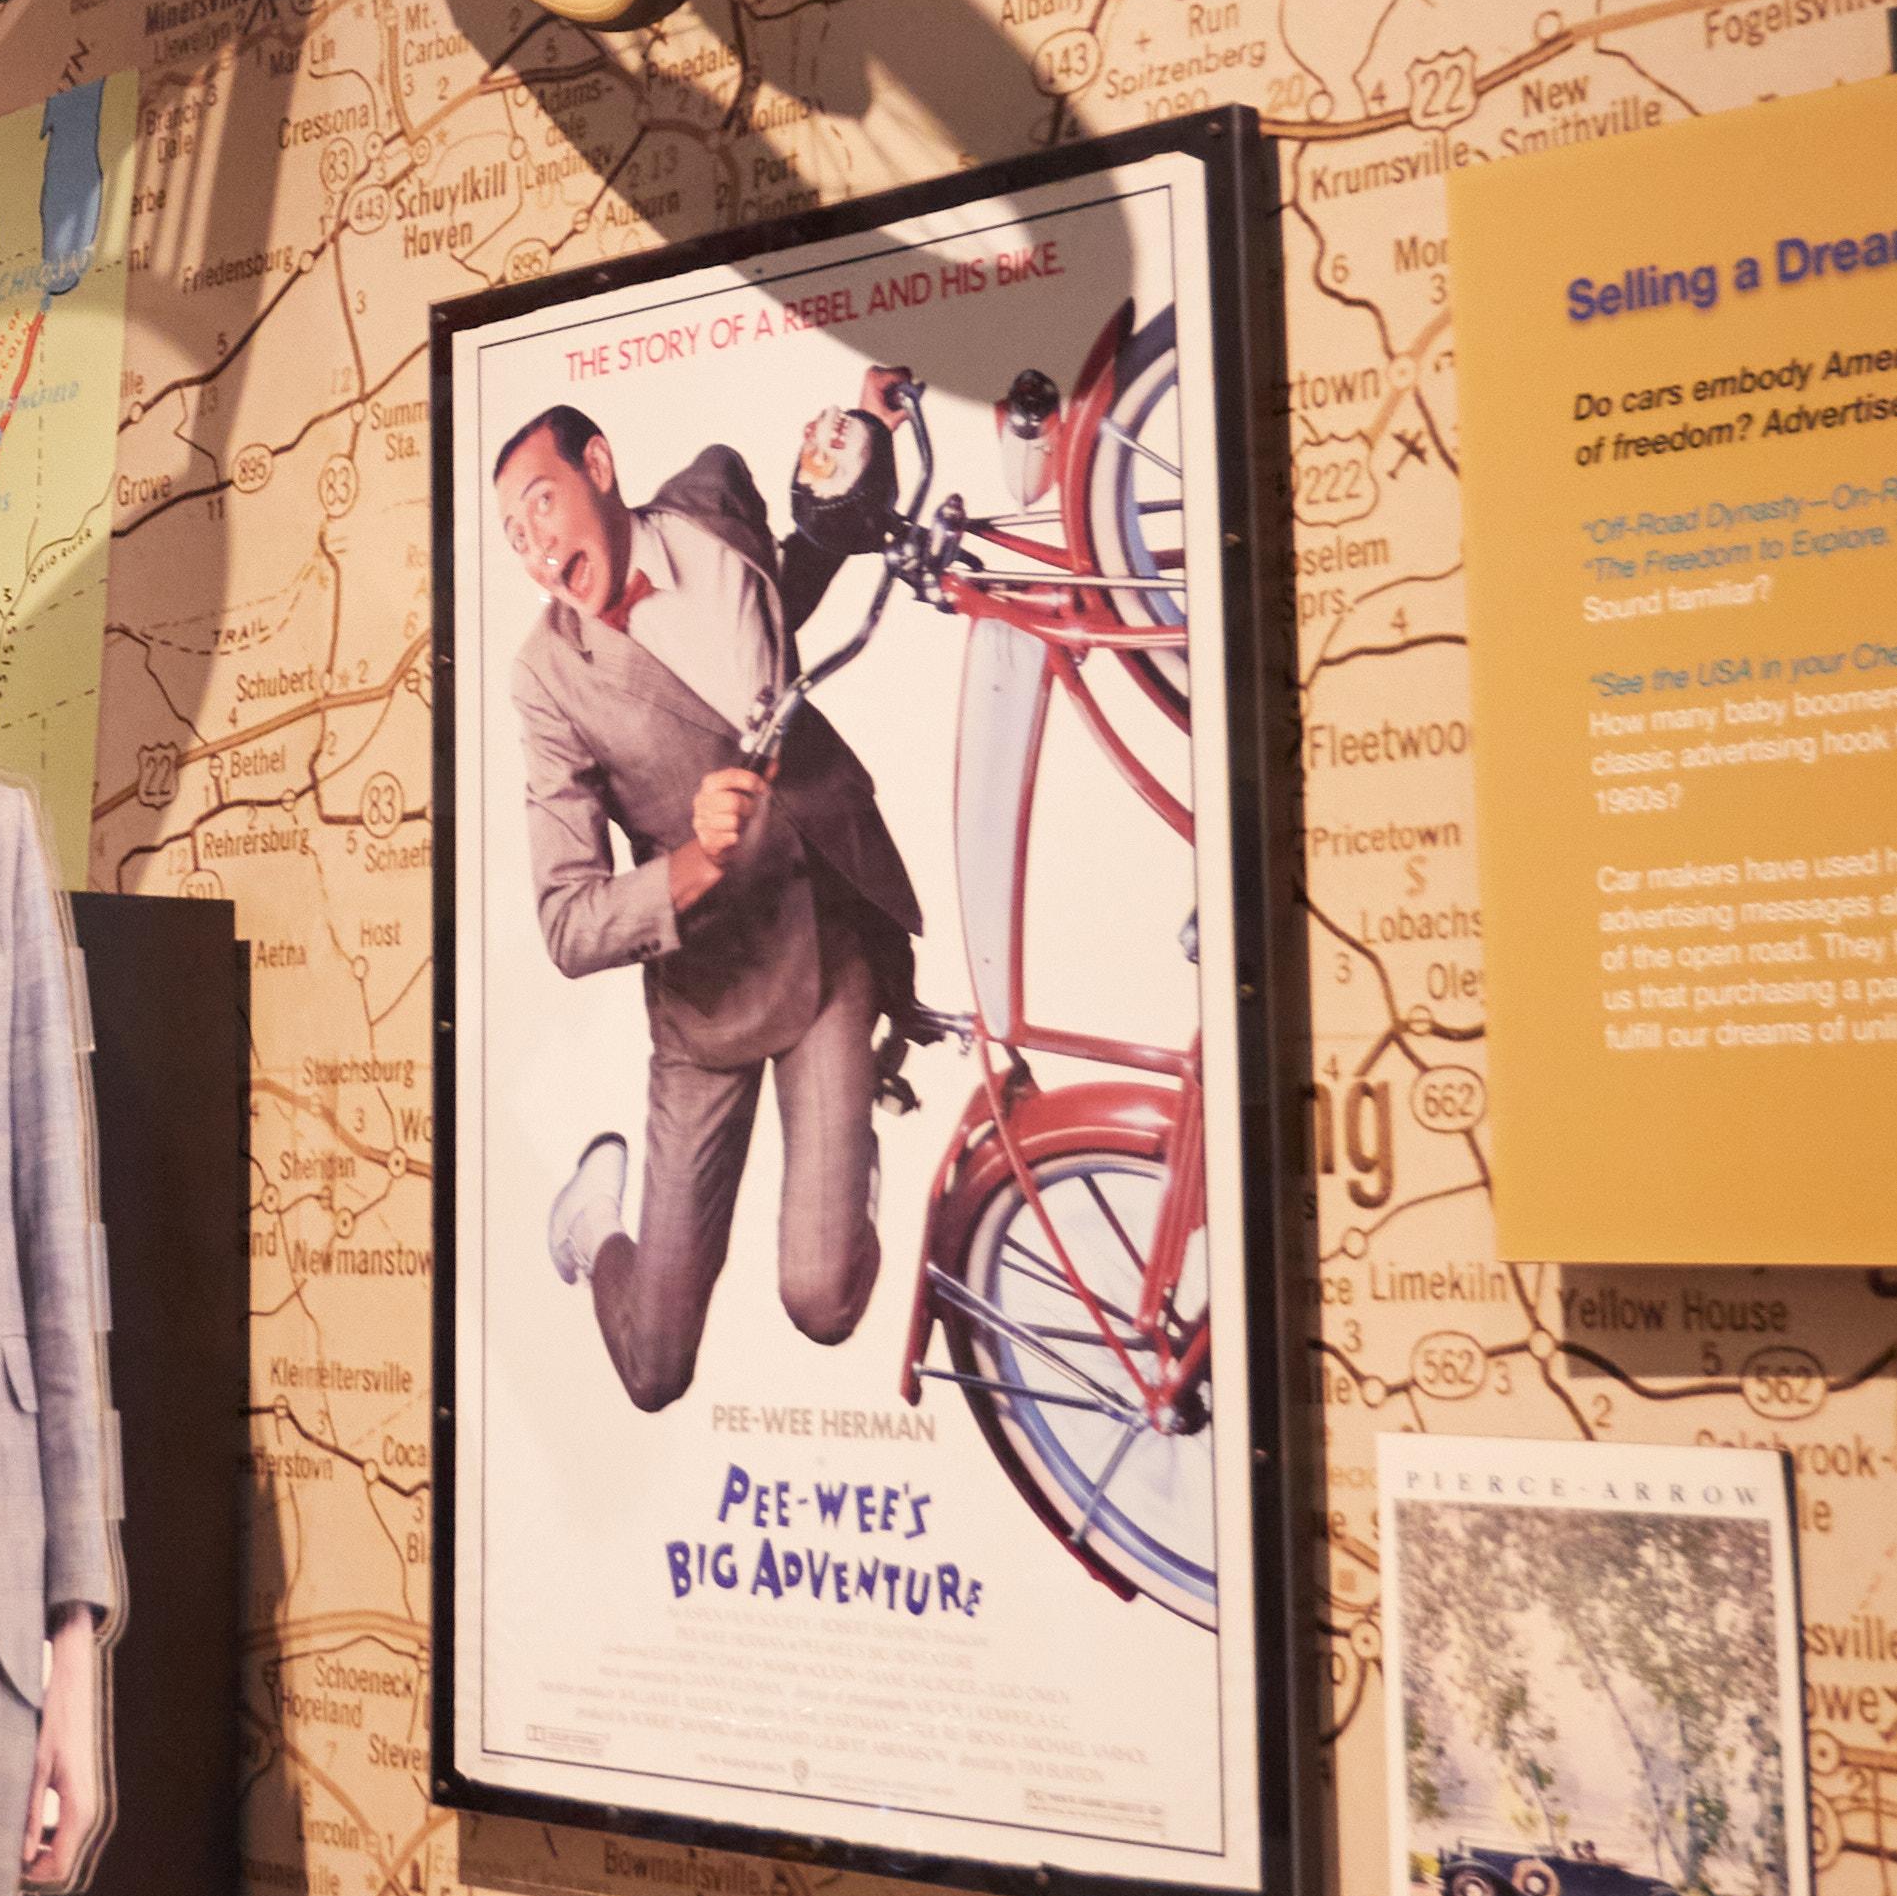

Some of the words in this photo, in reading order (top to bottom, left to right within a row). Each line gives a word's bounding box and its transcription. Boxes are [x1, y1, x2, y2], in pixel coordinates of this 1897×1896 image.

[1188, 0, 1240, 39] Run
[1418, 66, 1465, 117] 22
[395, 162, 508, 220] Schuylkill
[1310, 139, 1468, 203] Krumsville
[404, 222, 473, 260] Haven
[1568, 264, 1718, 321] Selling
[1734, 258, 1760, 290] a
[565, 343, 611, 382] THE
[617, 320, 701, 373] STORY
[708, 313, 747, 350] OF
[752, 307, 775, 341] A
[781, 291, 859, 334] REBEL
[867, 273, 933, 316] AND
[940, 255, 987, 297] HIS
[1574, 393, 1612, 420] Do
[1622, 384, 1683, 413] cars
[1692, 358, 1813, 401] embody
[1576, 438, 1604, 466] of
[1613, 413, 1753, 460] freedom?
[1583, 589, 1661, 622] Sound
[1668, 574, 1773, 610] familiar?
[235, 667, 314, 703] Schubert
[1652, 669, 1689, 691] the
[1697, 658, 1753, 686] USA
[1761, 658, 1781, 679] in
[1789, 652, 1845, 684] your
[1590, 712, 1644, 736] How
[1652, 706, 1717, 732] many
[1724, 696, 1787, 725] baby
[230, 747, 286, 776] Bethel
[1591, 745, 1675, 775] classic
[1680, 734, 1816, 769] advertising
[1822, 725, 1888, 755] hook
[1595, 782, 1682, 814] 1960s?
[203, 824, 309, 859] Rehrersburg
[1310, 817, 1461, 857] Pricetown
[1597, 865, 1640, 893] Car
[1648, 861, 1739, 889] makers
[1744, 857, 1806, 882] have
[1814, 848, 1878, 878] used
[1601, 945, 1627, 971] of
[1632, 944, 1672, 970] the
[1677, 943, 1741, 971] open
[1748, 936, 1814, 963] road.
[1820, 932, 1885, 962] They
[1422, 1080, 1475, 1119] 662
[1560, 1287, 1665, 1331] Yellow
[1682, 1295, 1789, 1332] House
[712, 1405, 813, 1436] PEE-WEE
[821, 1411, 936, 1442] HERMAN
[717, 1462, 931, 1539] PEE-WEE'S
[666, 1541, 738, 1598] BIG
[750, 1538, 982, 1618] ADVENTURE
